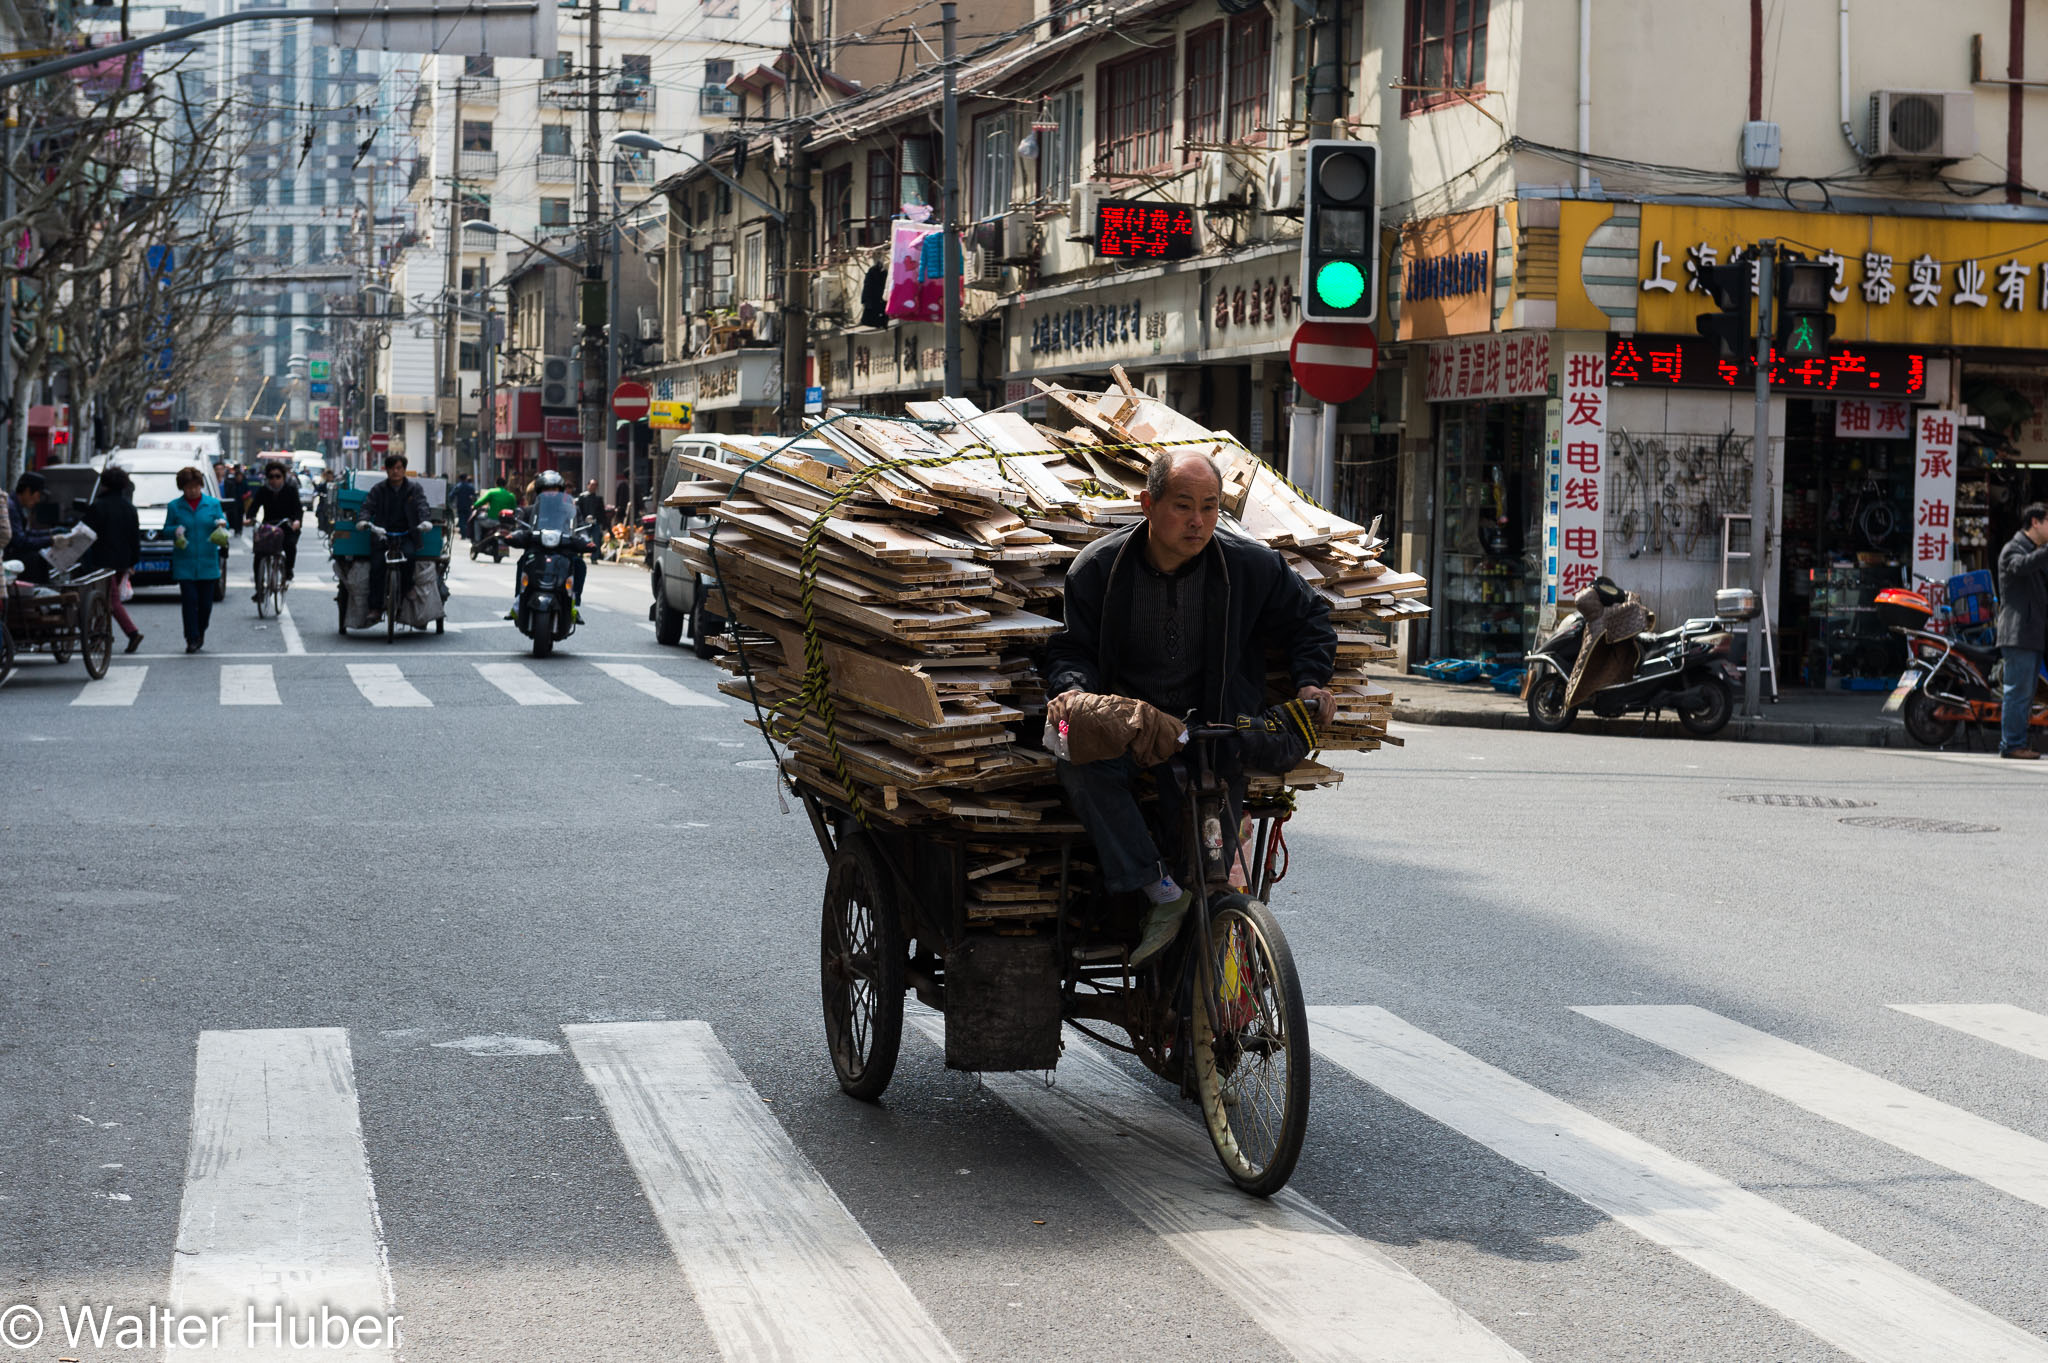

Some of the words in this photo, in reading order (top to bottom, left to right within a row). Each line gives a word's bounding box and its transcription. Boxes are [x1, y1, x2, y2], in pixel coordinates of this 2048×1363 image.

[1567, 354, 1604, 426] 批发
[1610, 341, 1682, 383] 公司
[1840, 401, 1906, 431] 轴承
[1920, 415, 1954, 479] 轴承
[1564, 440, 1601, 511] 电线
[1562, 526, 1599, 596] 电缆
[1918, 499, 1950, 562] 油封
